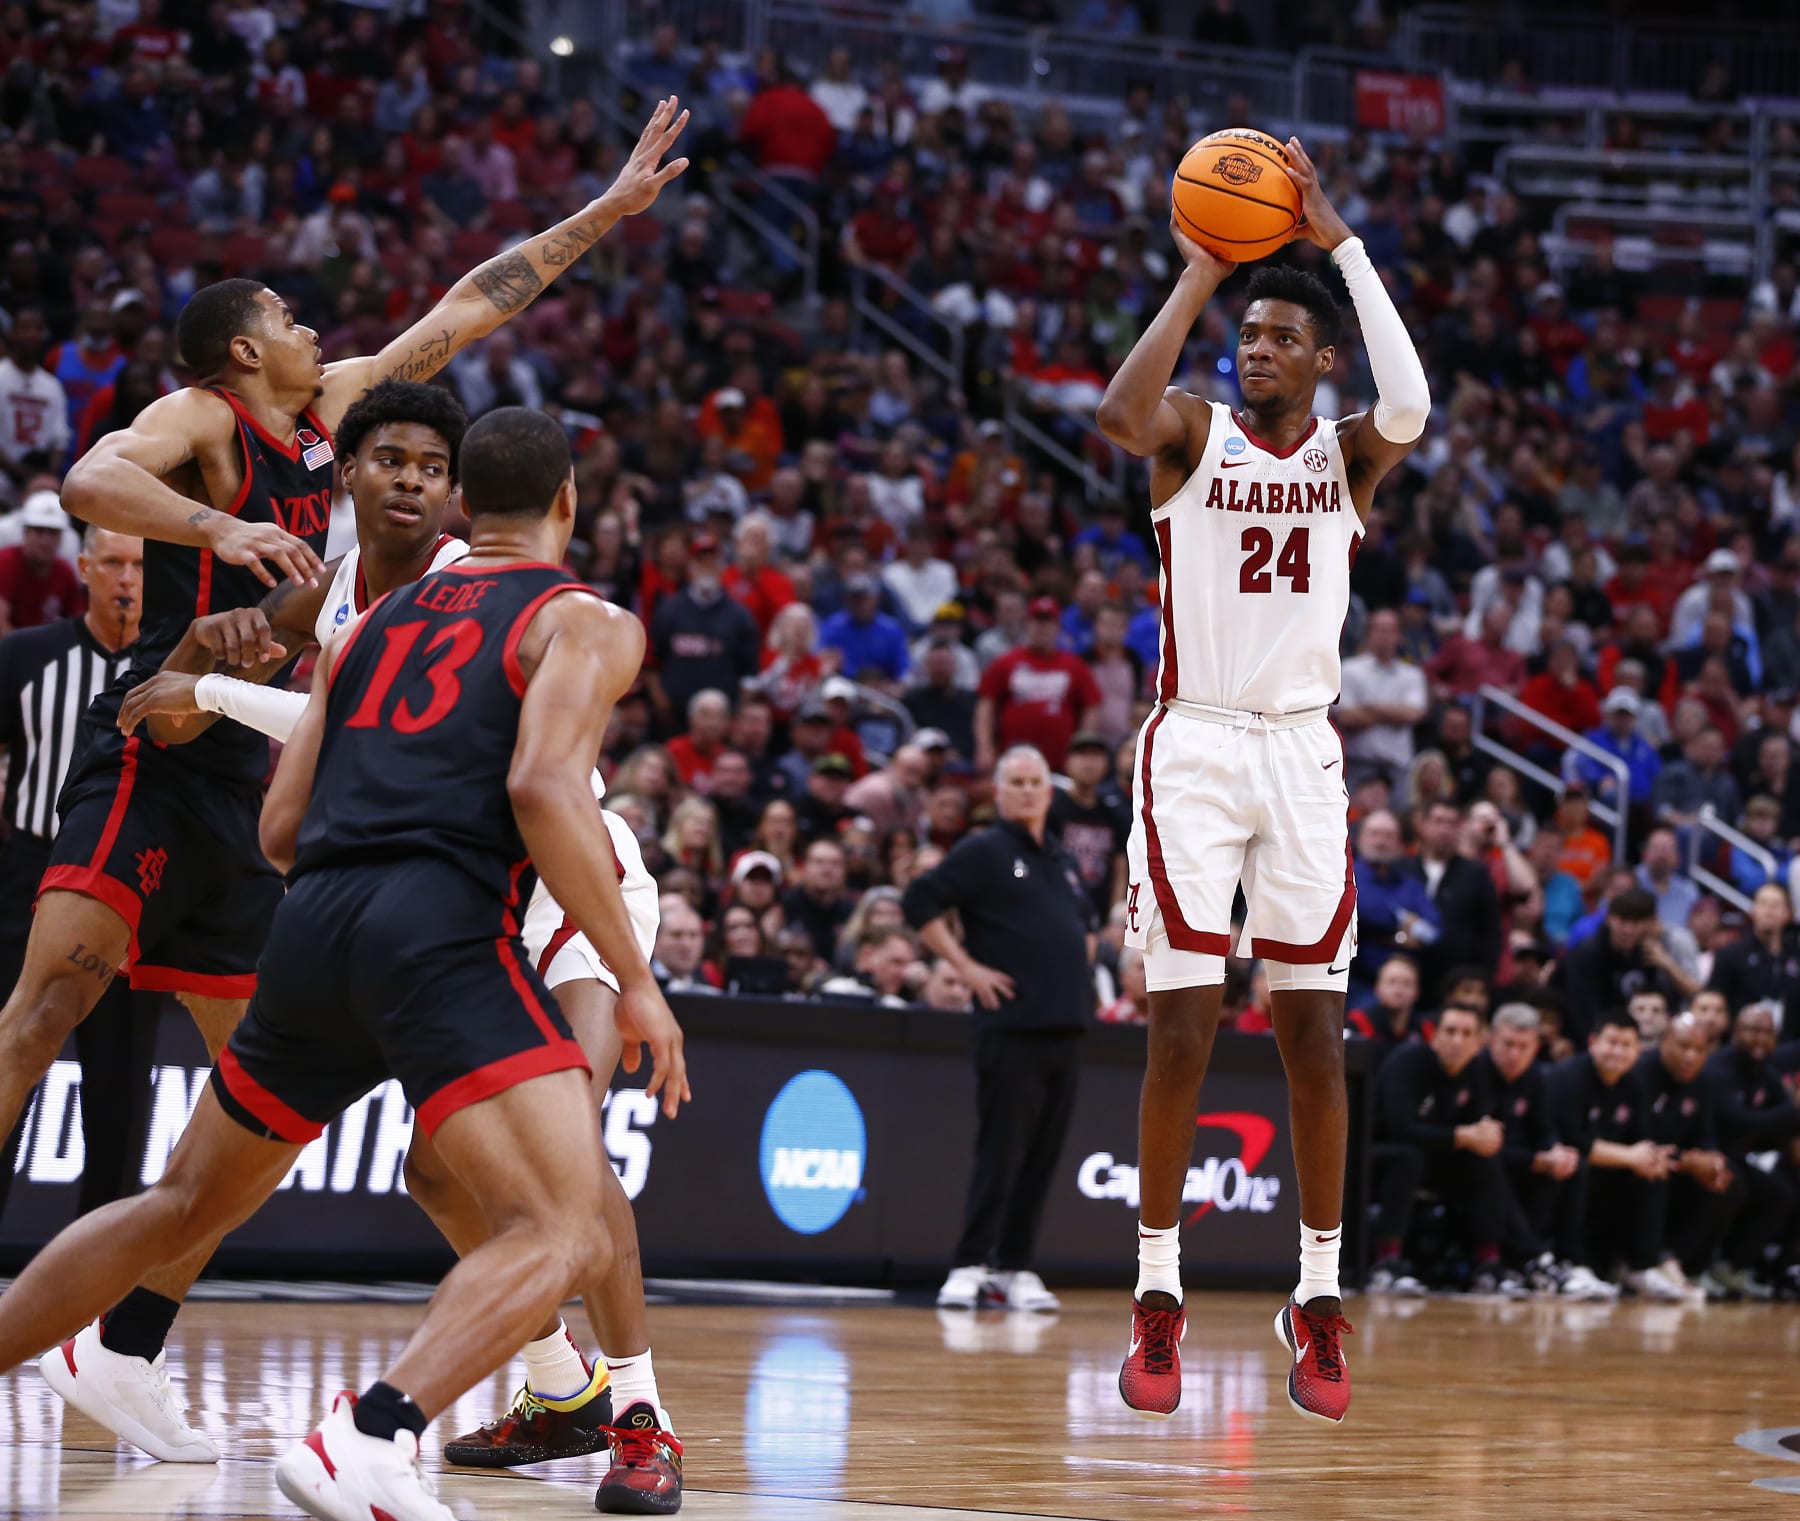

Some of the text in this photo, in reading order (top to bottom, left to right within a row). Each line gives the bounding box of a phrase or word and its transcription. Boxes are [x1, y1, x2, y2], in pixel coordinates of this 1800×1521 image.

[1226, 157, 1251, 171] MARCH
[1227, 165, 1259, 182] MADNESS
[1305, 449, 1328, 471] SEC
[1205, 478, 1341, 513] ALABAMA
[1240, 526, 1311, 593] 24
[344, 617, 484, 734] 13
[770, 1147, 860, 1190] NCAA
